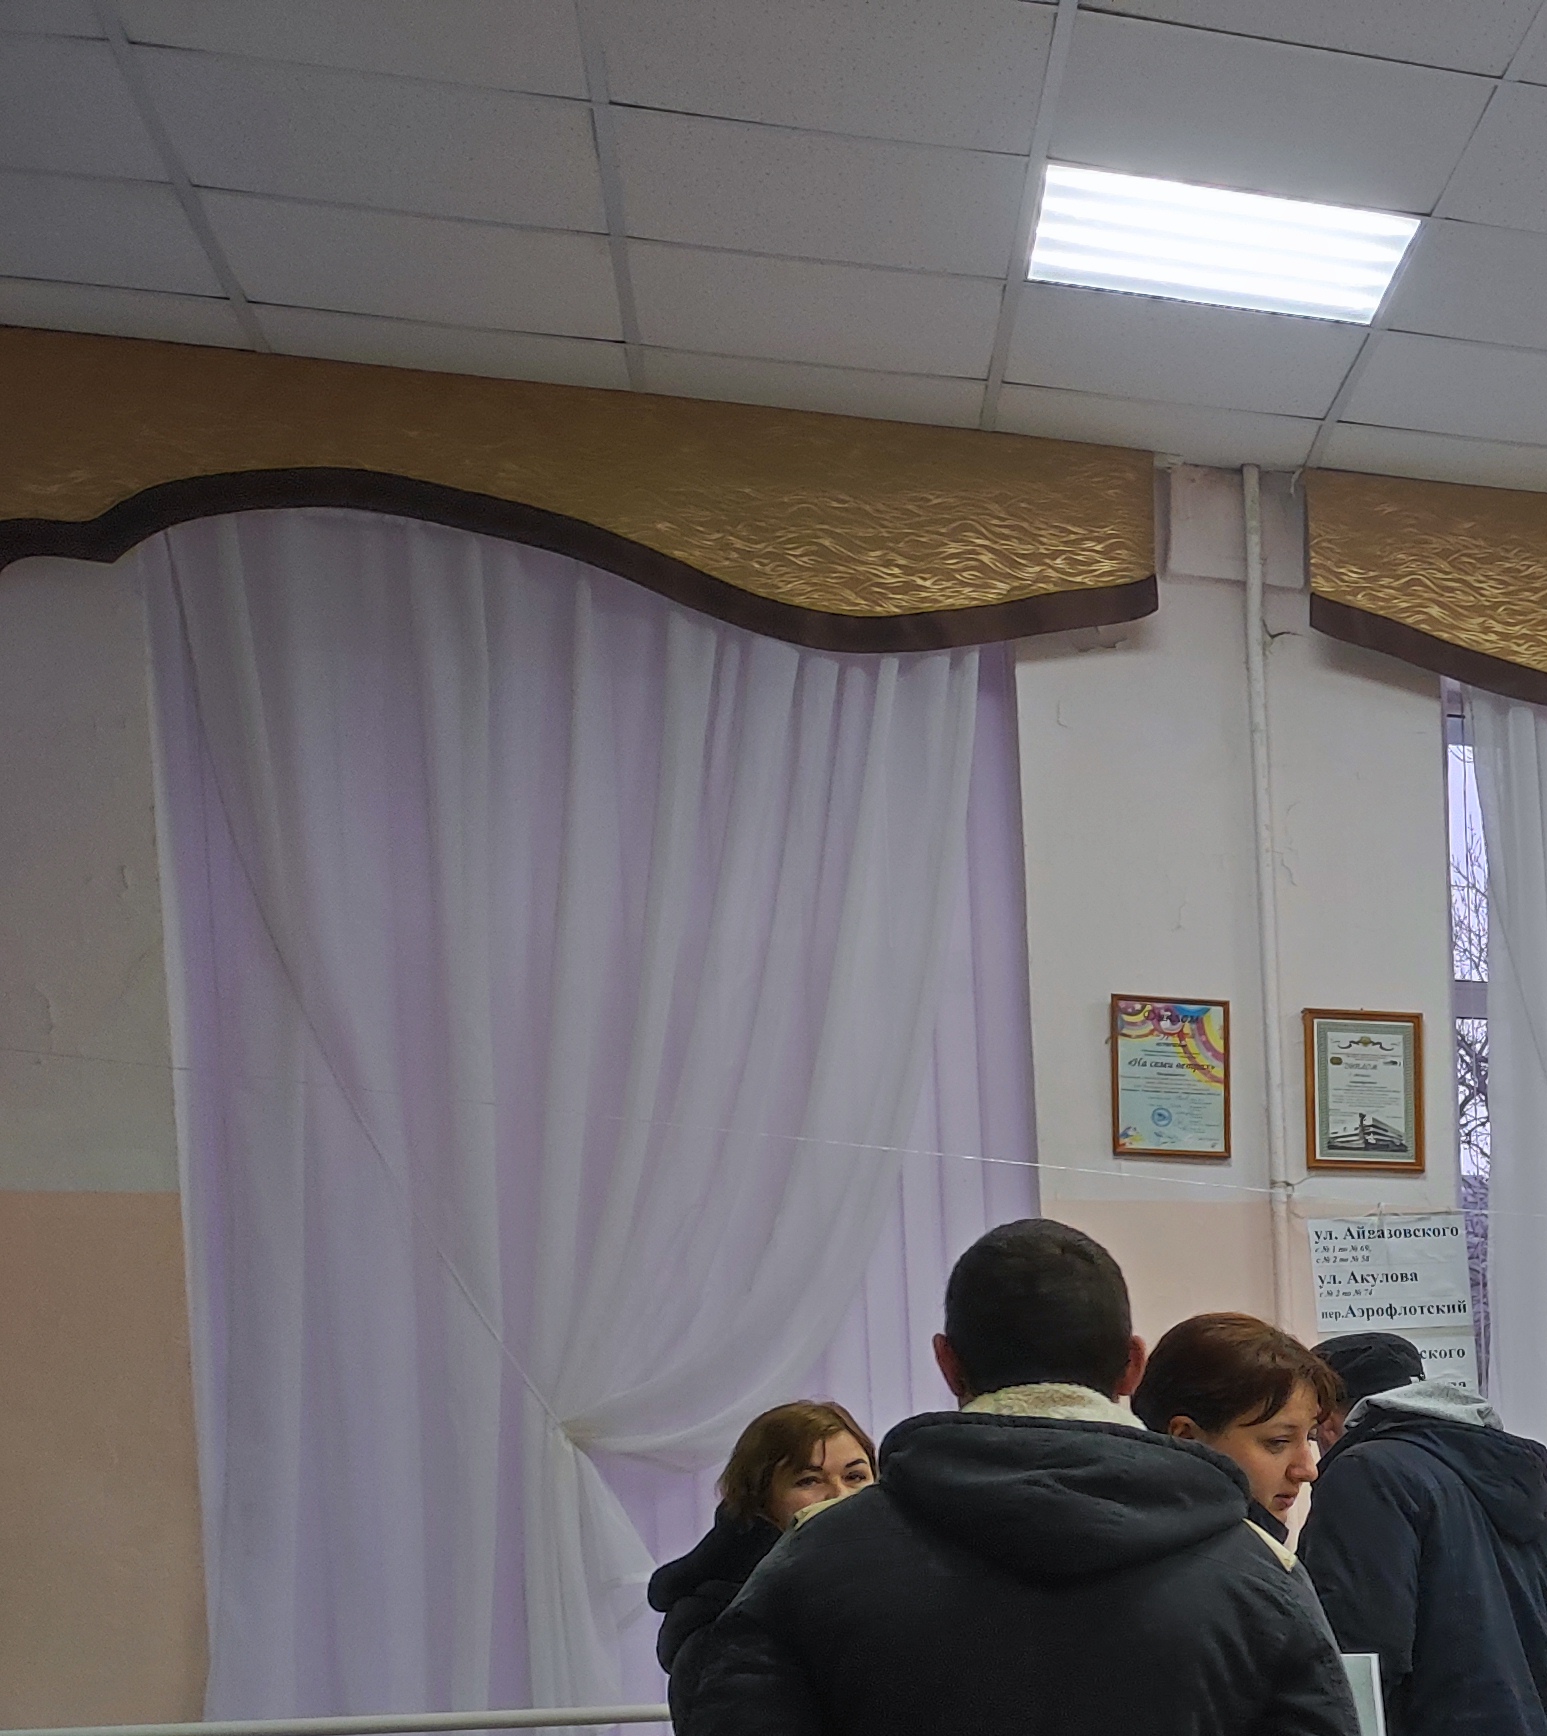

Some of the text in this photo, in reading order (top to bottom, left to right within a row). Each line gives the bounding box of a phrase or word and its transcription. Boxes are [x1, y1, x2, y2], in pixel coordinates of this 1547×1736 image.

[1314, 1225, 1460, 1244] ул. Айвазовского
[1318, 1270, 1419, 1289] ул. Акулова
